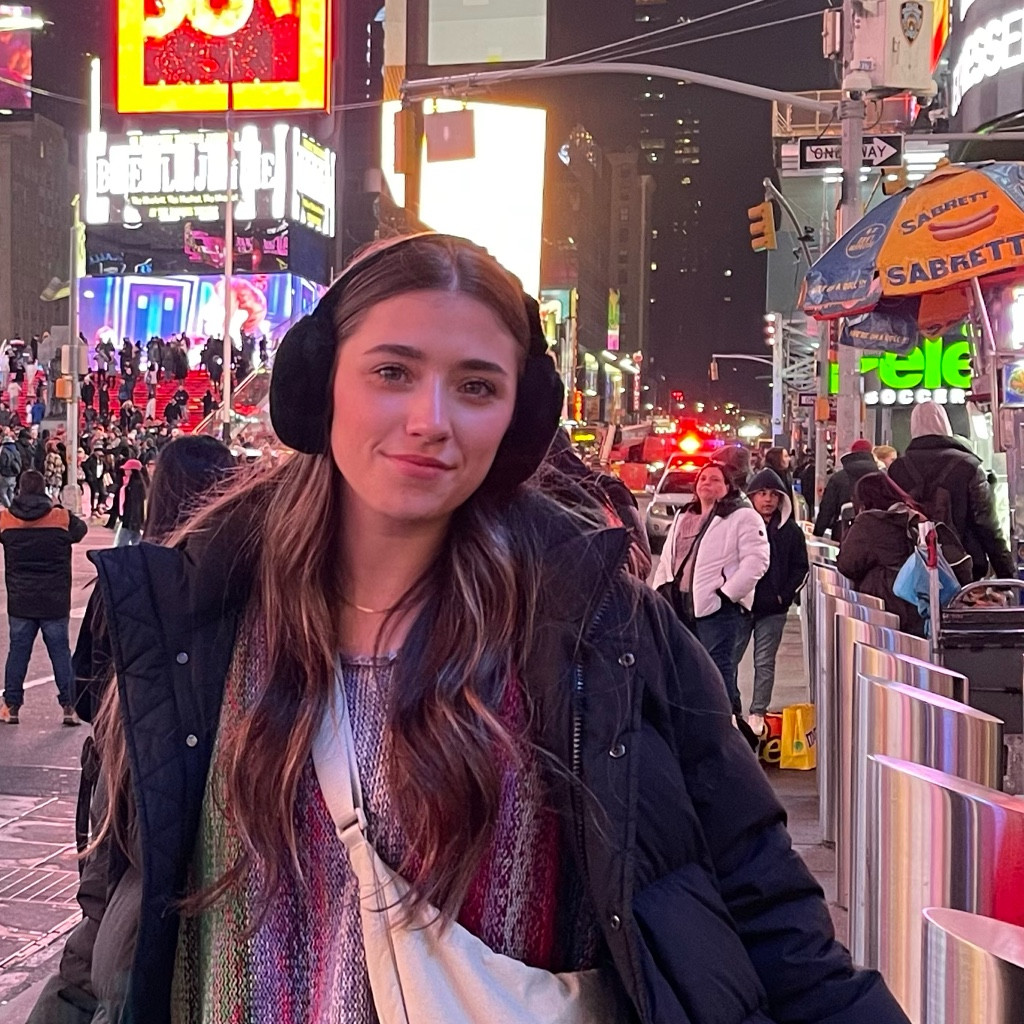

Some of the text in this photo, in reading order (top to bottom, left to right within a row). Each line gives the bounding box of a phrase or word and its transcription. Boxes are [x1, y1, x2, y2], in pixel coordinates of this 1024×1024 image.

[900, 190, 989, 236] SABRETT
[887, 233, 1024, 287] SABRETT
[863, 388, 968, 405] SOCCER
